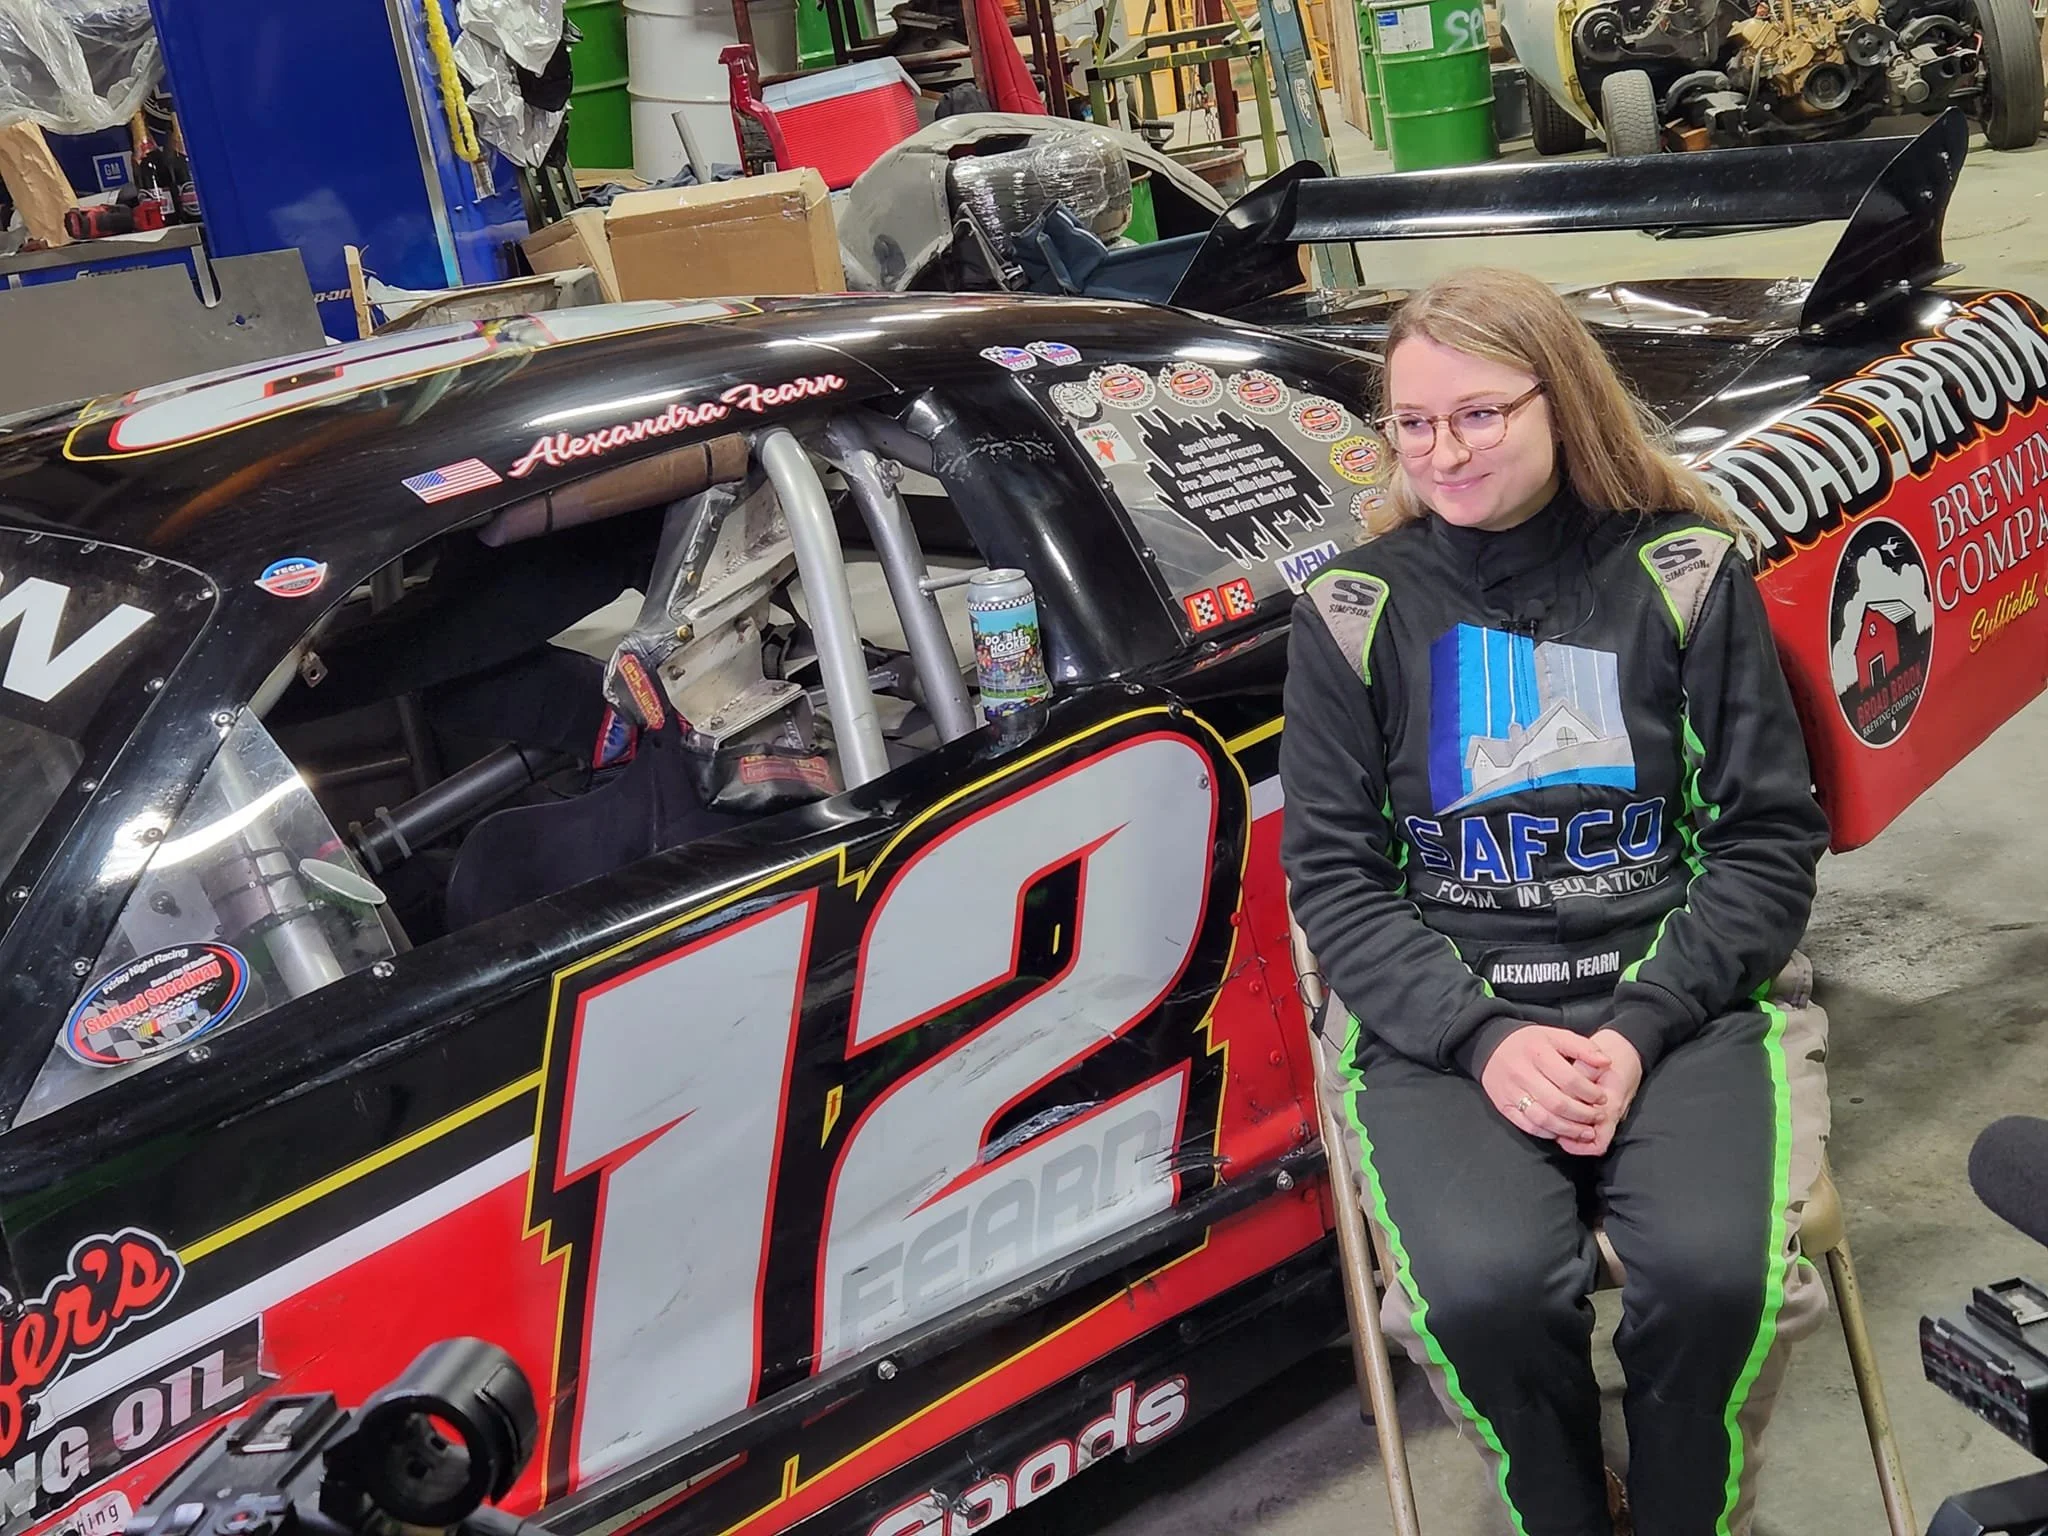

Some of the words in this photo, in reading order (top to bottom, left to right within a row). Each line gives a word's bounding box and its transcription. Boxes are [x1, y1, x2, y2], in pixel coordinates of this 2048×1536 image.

[103, 162, 122, 176] GM
[1834, 297, 2048, 463] BROOK
[506, 401, 730, 479] Alexandra
[721, 374, 847, 413] Fearn
[272, 563, 305, 576] TECH
[1665, 560, 1707, 583] SIMPSON
[1329, 603, 1370, 618] SIMPSON
[990, 635, 1031, 656] HOOKED
[1857, 687, 1889, 729] BROAD
[1890, 662, 1923, 703] BROOK
[1862, 708, 1892, 738] BREWING
[1891, 685, 1921, 715] COMPANY
[1404, 796, 1666, 883] SAFCO
[1436, 881, 1502, 909] FOAM
[102, 970, 130, 995] Friday
[128, 958, 156, 978] Night
[153, 948, 189, 965] Racing
[1492, 961, 1571, 984] ALEXANDRA
[1576, 951, 1620, 979] FEARN
[85, 990, 150, 1035] Stafford
[144, 960, 223, 1006] Speedway
[554, 731, 1219, 1492] 12
[111, 1349, 244, 1452] OIL
